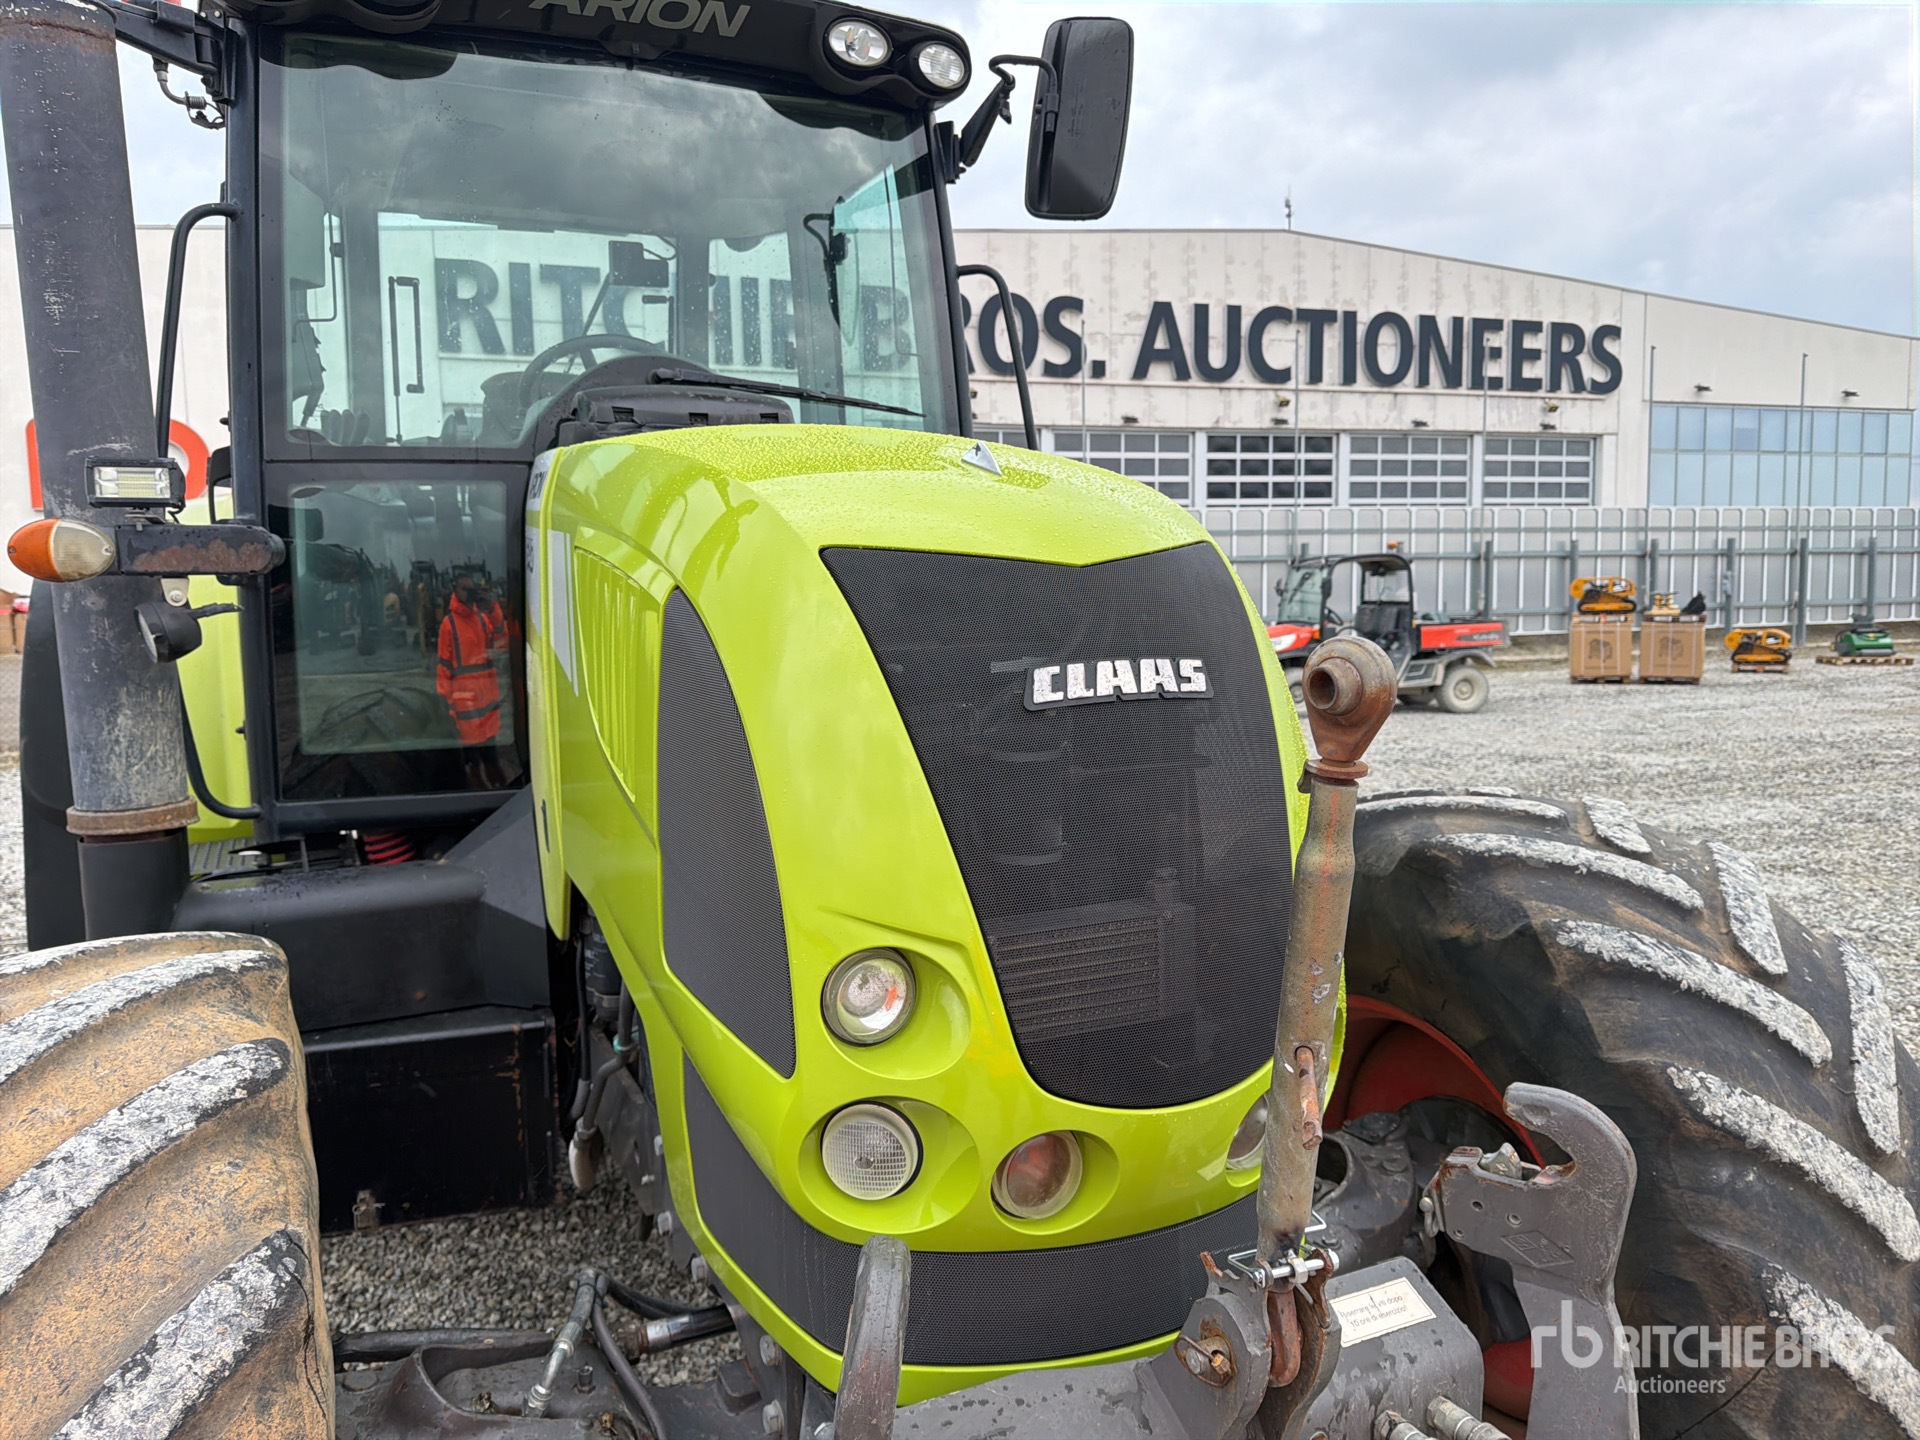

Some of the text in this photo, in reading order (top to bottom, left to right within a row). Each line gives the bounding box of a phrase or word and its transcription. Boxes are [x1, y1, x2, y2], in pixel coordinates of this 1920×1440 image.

[861, 286, 1106, 378] BOS.
[1132, 301, 1623, 395] AUCTIONEERS
[1033, 658, 1207, 704] CLAAS
[1339, 1305, 1369, 1319] Riserrare
[1386, 1295, 1403, 1305] dopo
[1350, 1319, 1360, 1328] 10
[1360, 1317, 1371, 1325] ore
